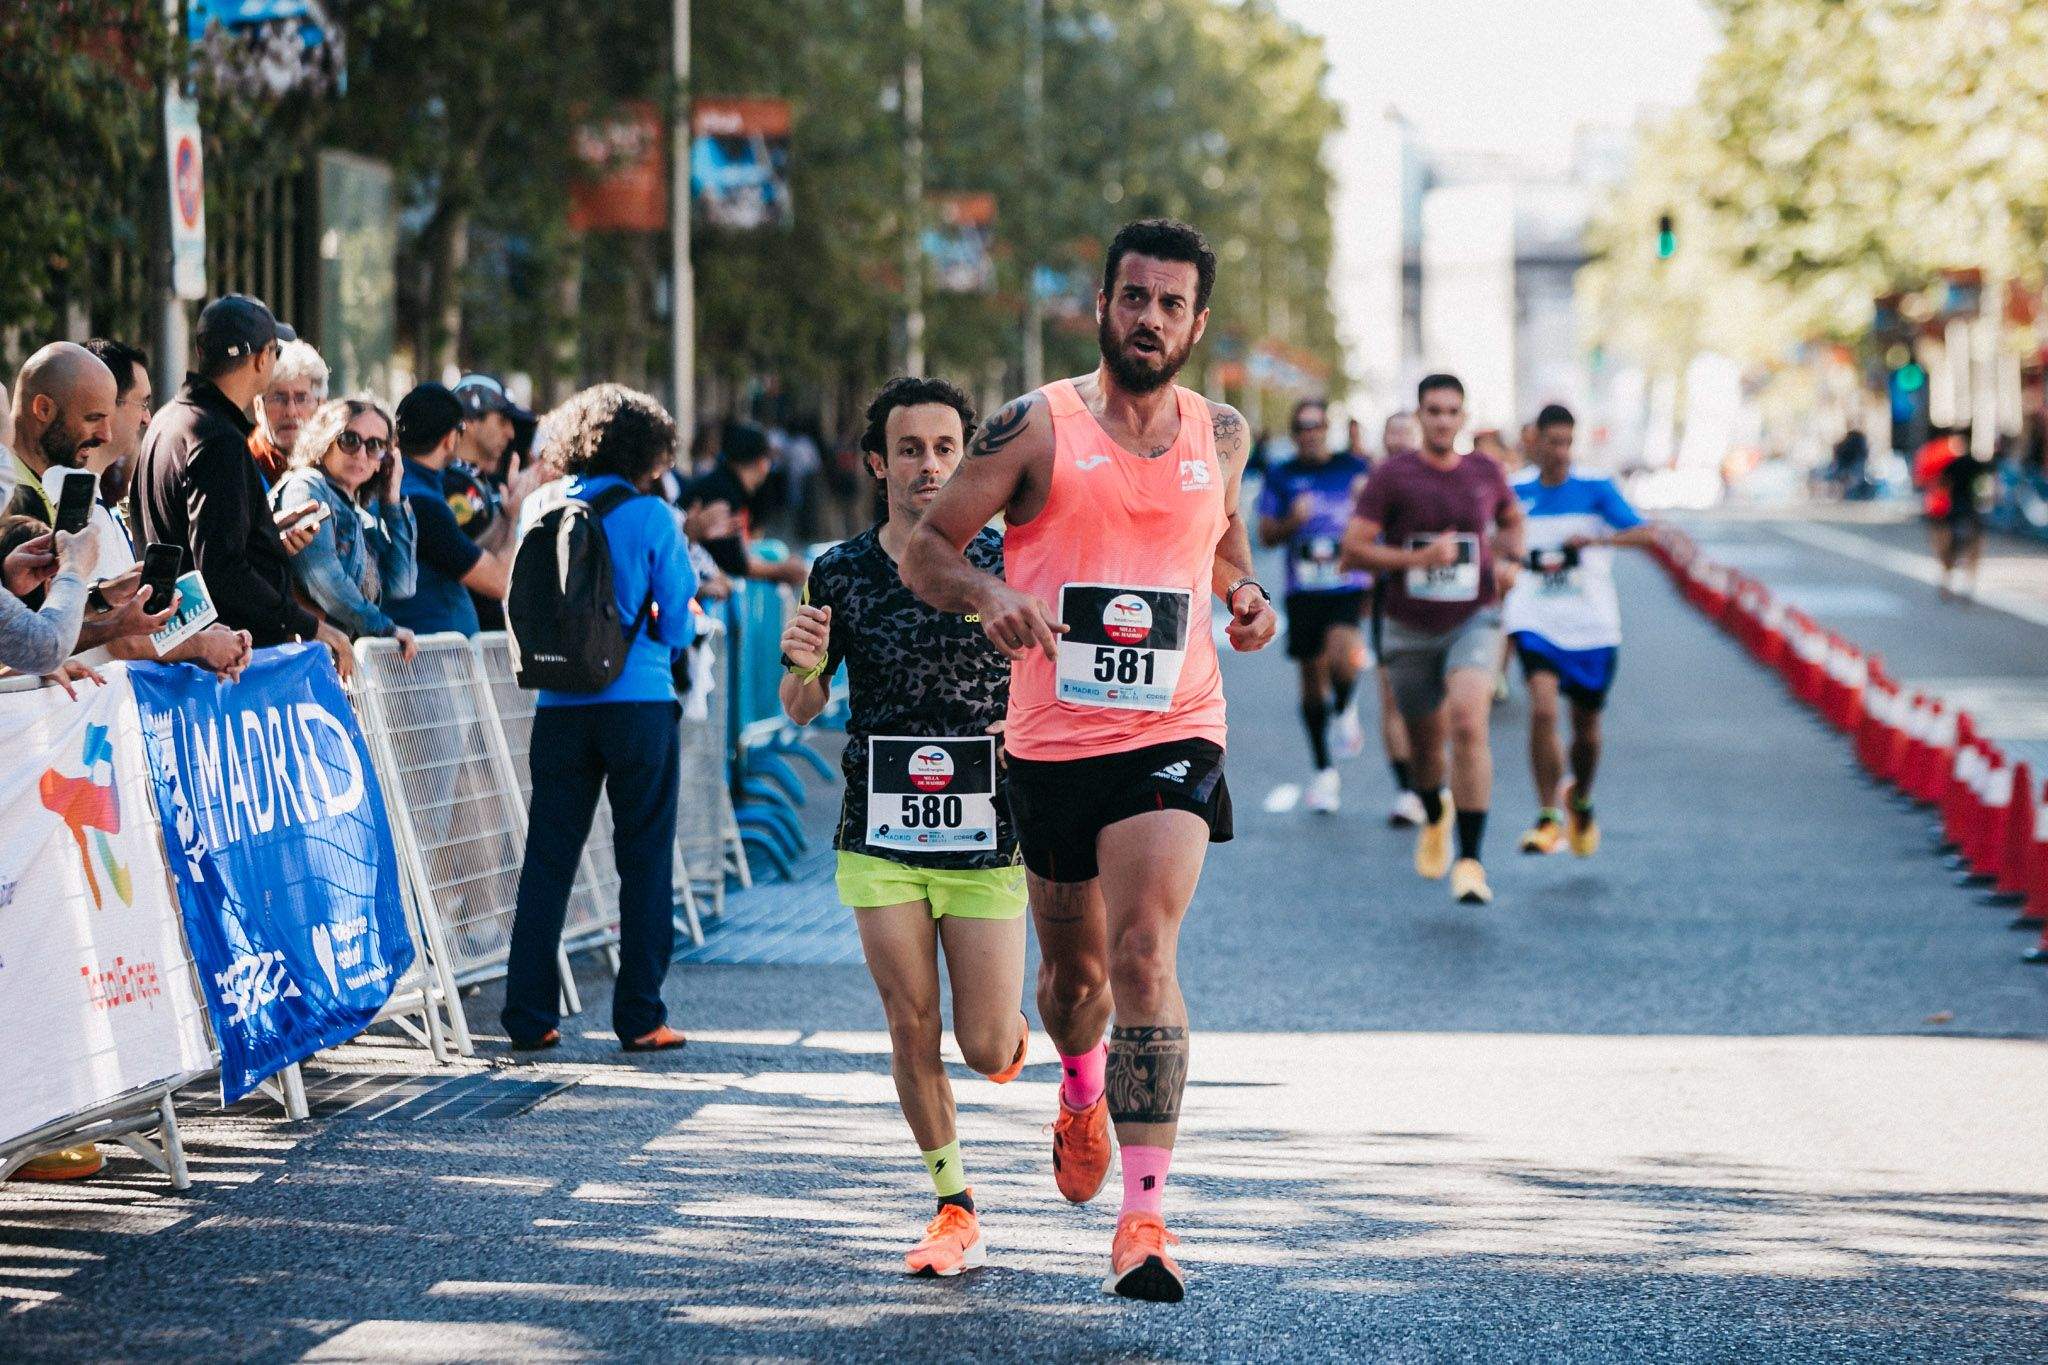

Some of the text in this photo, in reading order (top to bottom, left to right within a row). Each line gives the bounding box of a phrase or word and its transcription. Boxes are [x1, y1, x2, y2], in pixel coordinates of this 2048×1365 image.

[964, 613, 982, 623] ad
[1093, 646, 1155, 685] 581
[1072, 685, 1100, 696] MADRID
[193, 703, 364, 848] MADRID
[901, 795, 963, 828] 580
